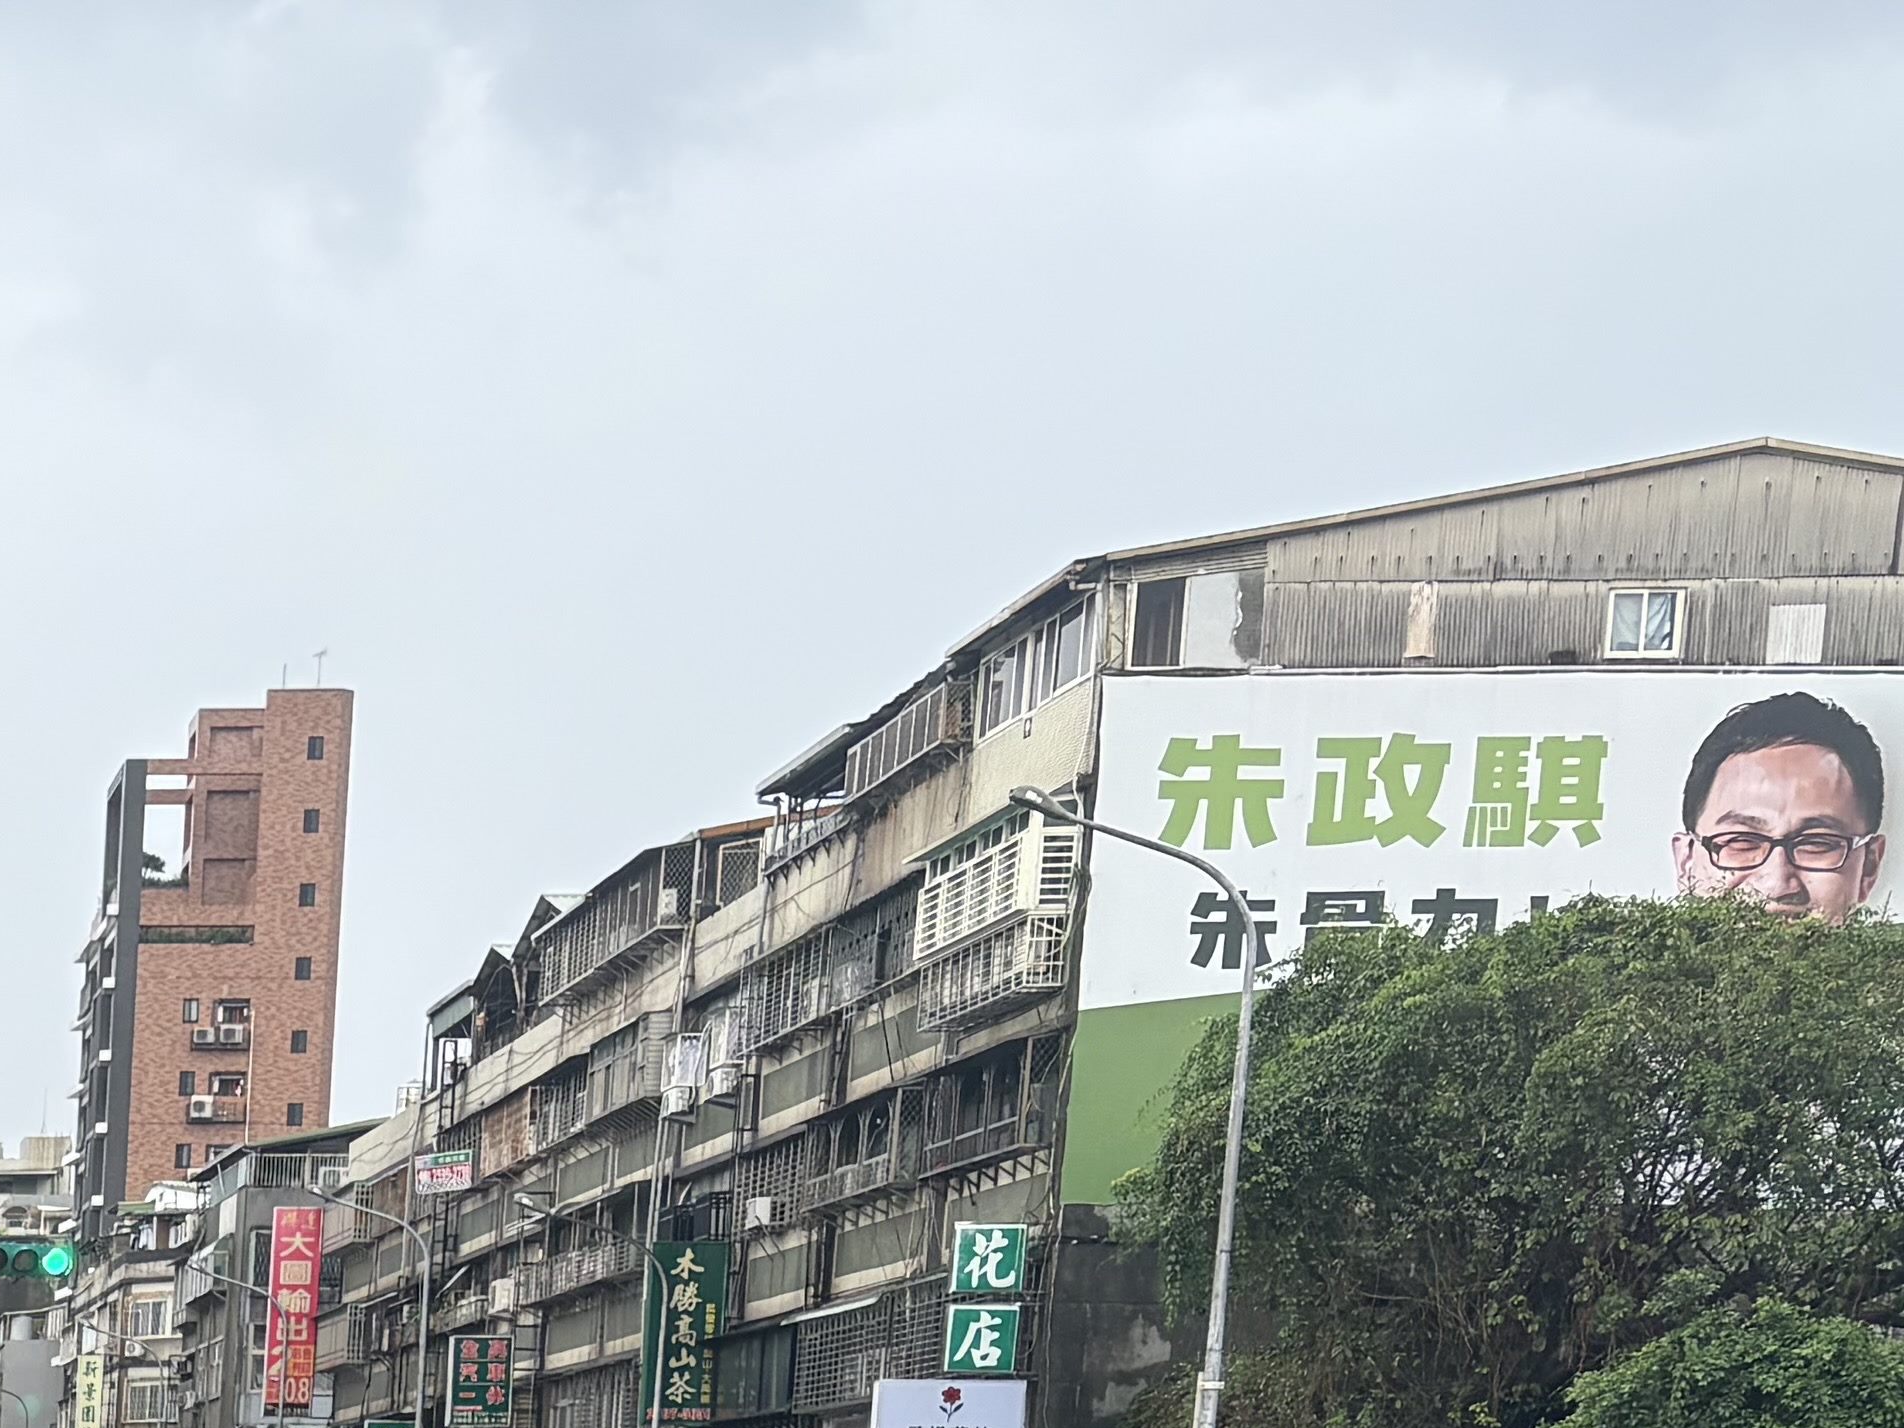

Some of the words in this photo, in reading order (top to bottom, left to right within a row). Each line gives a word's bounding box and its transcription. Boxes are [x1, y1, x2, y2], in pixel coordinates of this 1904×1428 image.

[1157, 733, 1608, 850] 朱政騏
[665, 1248, 704, 1404] 木勝高山茶
[954, 1238, 1015, 1370] 花店
